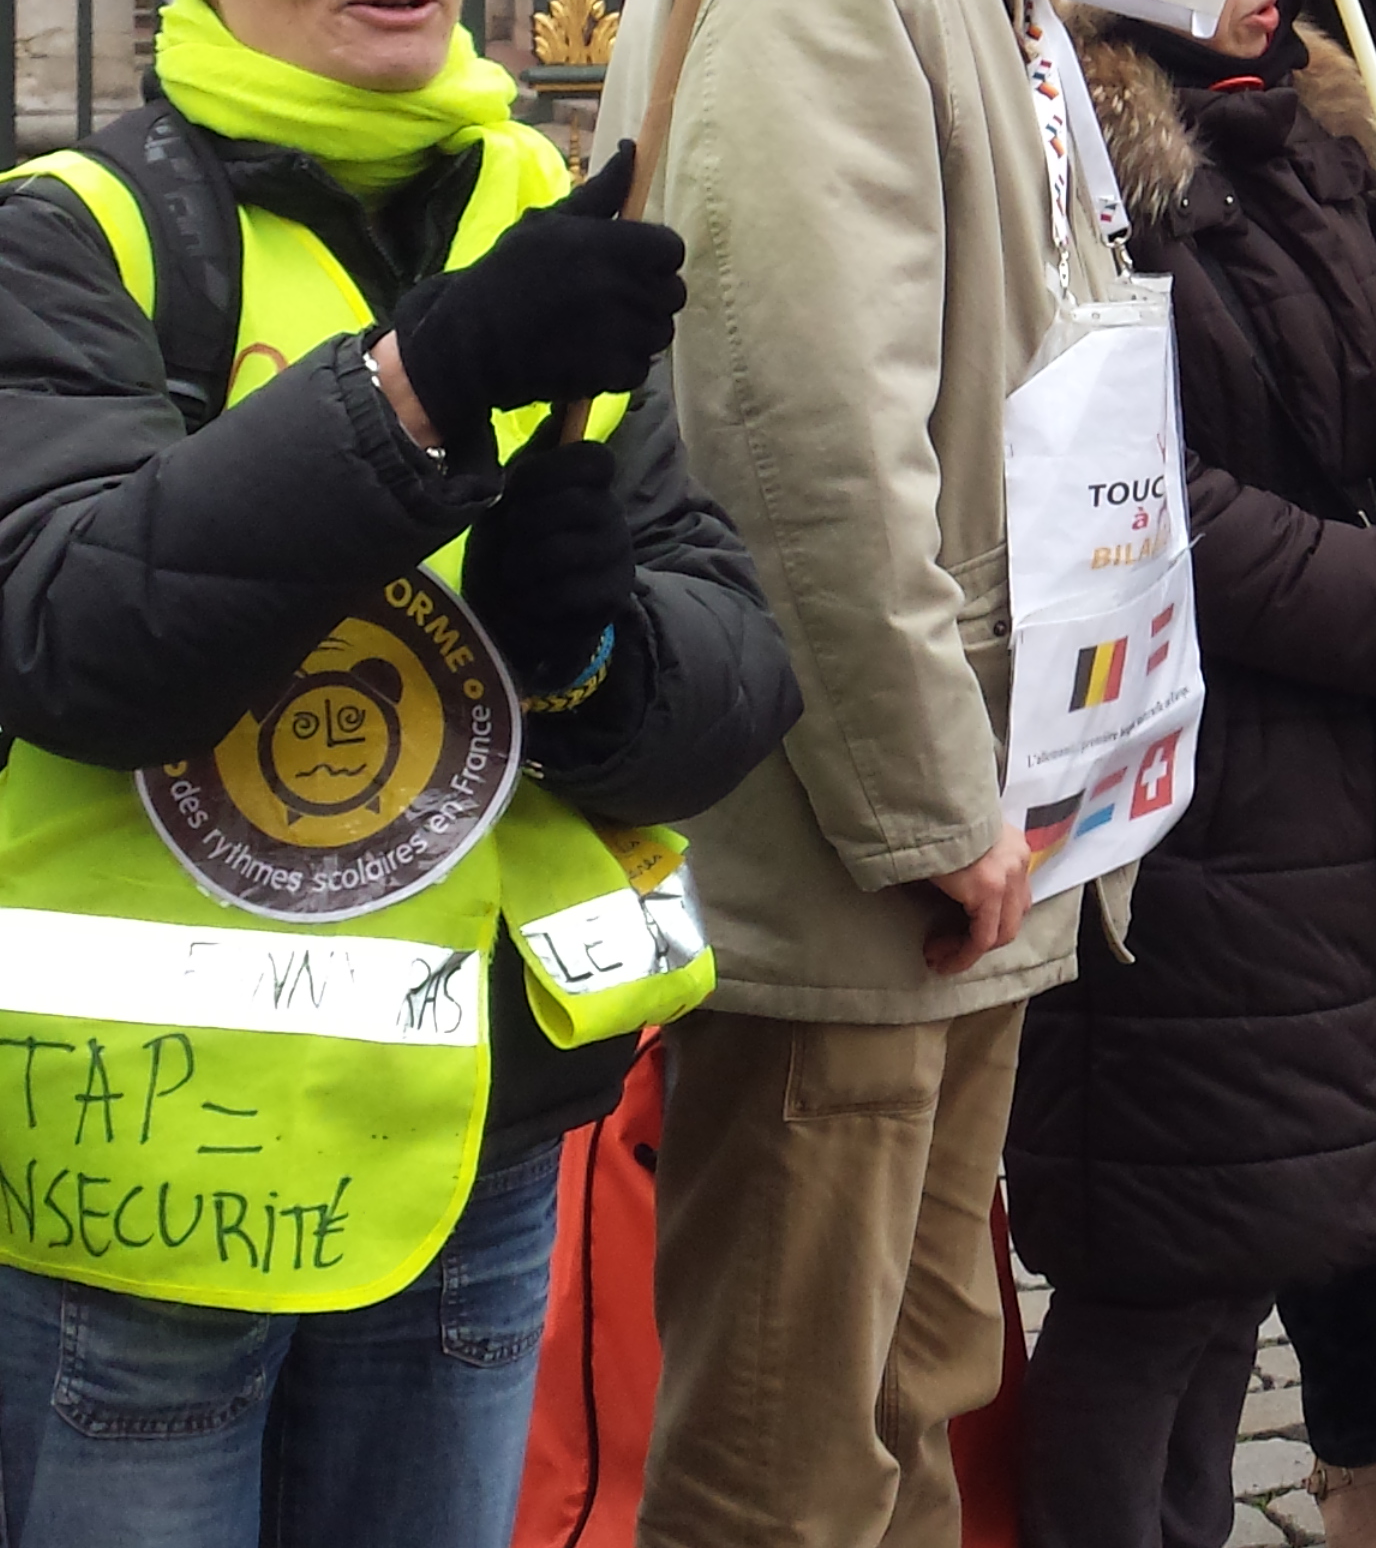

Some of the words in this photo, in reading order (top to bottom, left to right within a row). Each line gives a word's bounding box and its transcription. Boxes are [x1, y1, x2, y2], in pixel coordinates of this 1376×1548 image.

[1131, 506, 1150, 531] à
[170, 779, 209, 829] des
[202, 827, 303, 893] rythmes
[312, 835, 428, 893] scolaires
[428, 798, 463, 834] en
[450, 704, 492, 795] France
